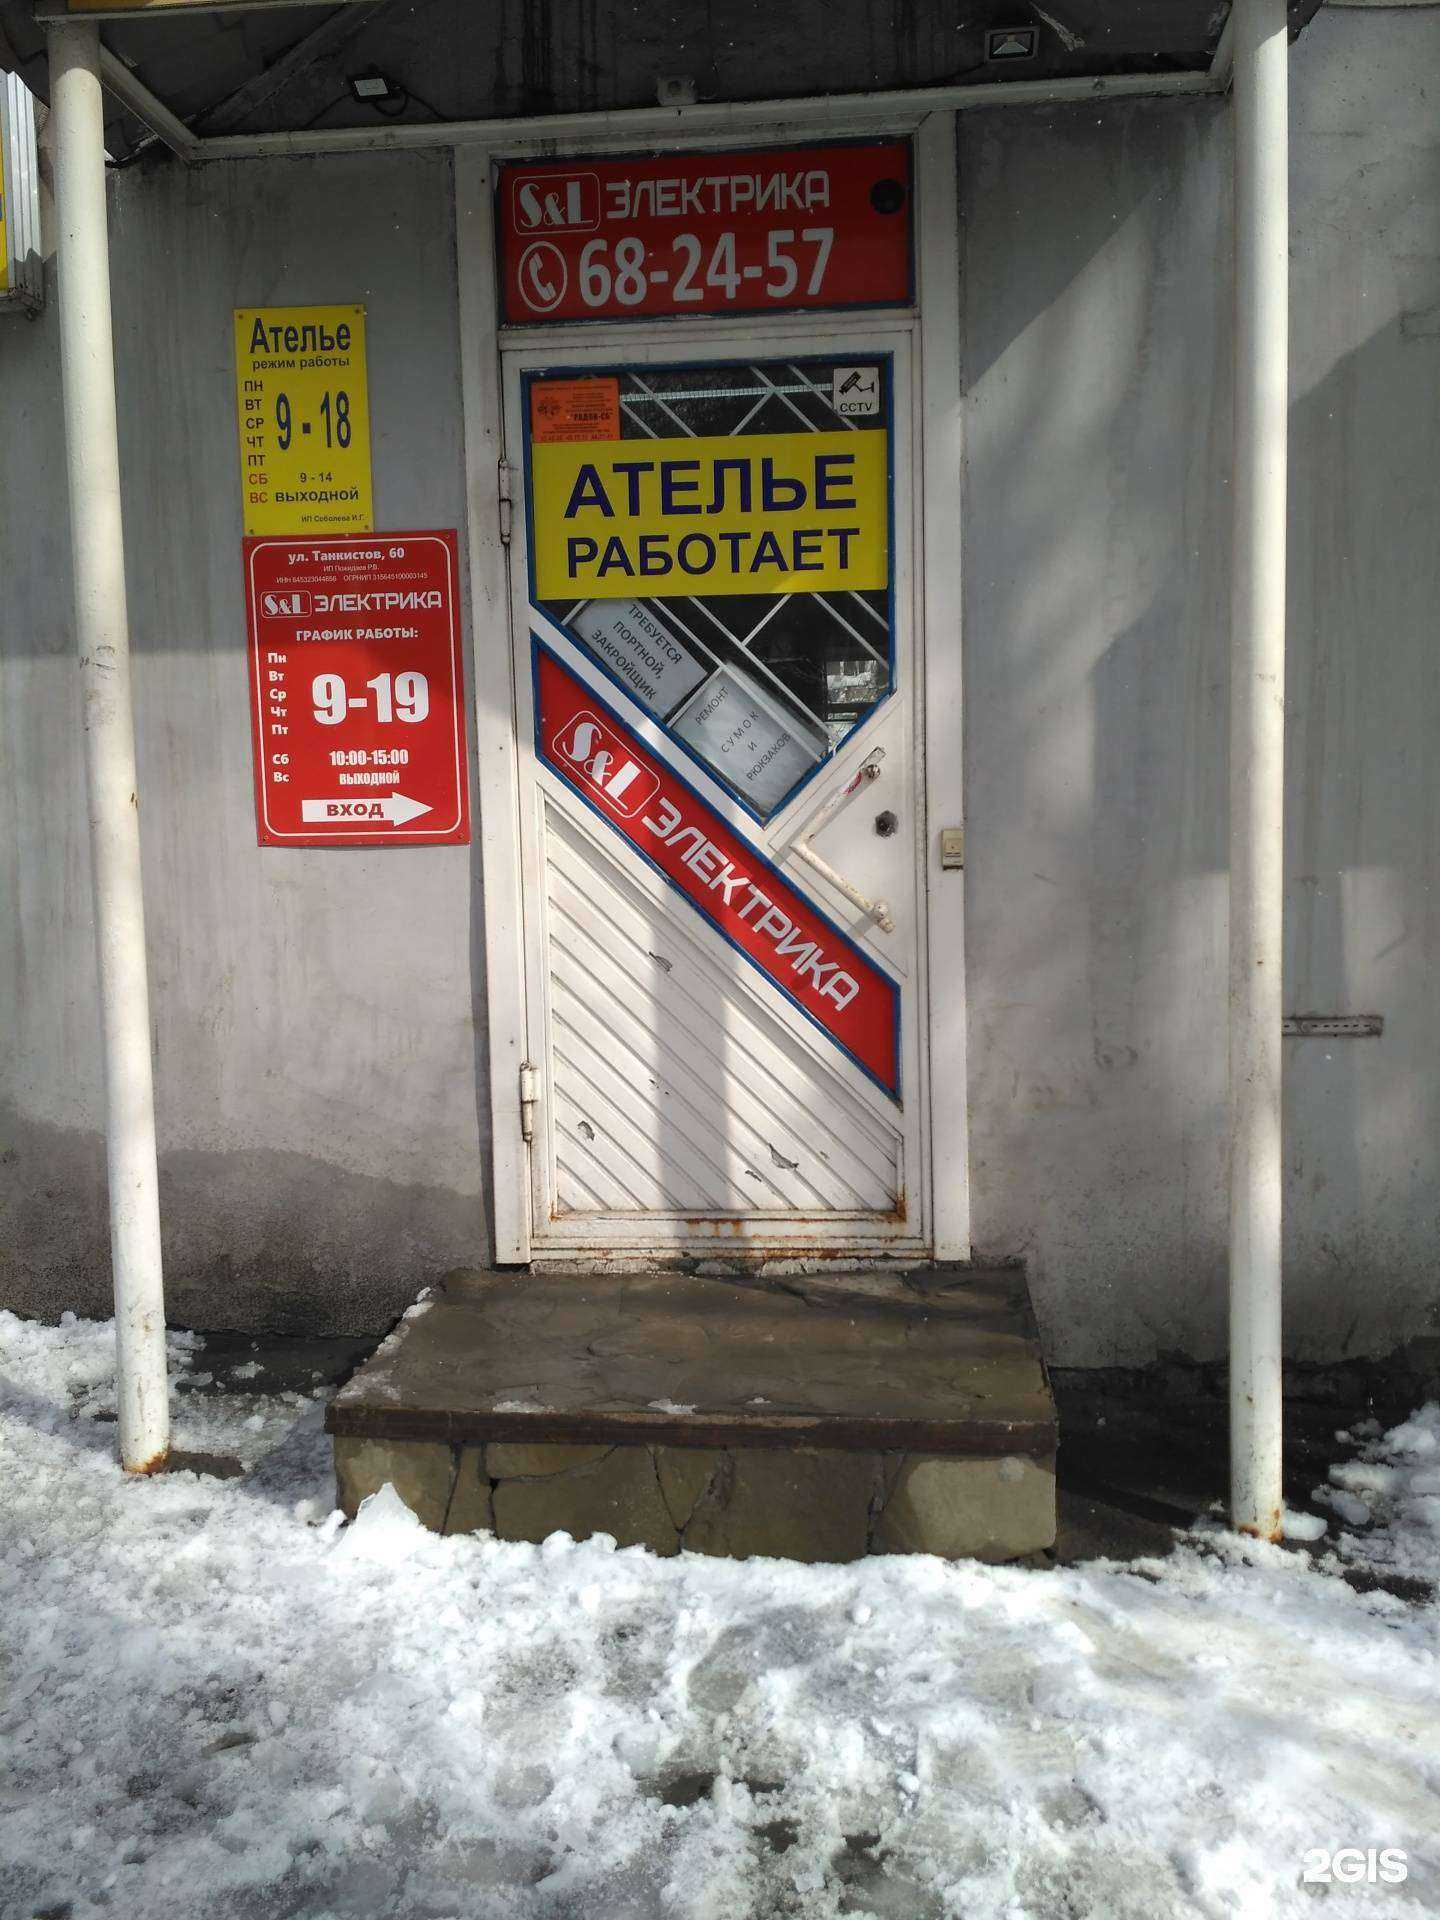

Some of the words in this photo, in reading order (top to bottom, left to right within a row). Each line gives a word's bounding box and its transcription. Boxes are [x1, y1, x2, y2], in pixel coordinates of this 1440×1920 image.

[605, 171, 831, 218] ЭЛЕКТРИКА
[519, 181, 594, 228] S&L
[579, 227, 835, 306] 68-24-57
[250, 317, 351, 353] Ателье
[252, 359, 296, 371] режим
[300, 356, 350, 370] работы
[244, 380, 264, 392] ПН
[245, 399, 262, 410] ВТ
[840, 402, 872, 413] CCTV
[246, 417, 264, 429] СР
[276, 392, 291, 450] 9
[320, 390, 351, 448] 18
[247, 436, 264, 448] ЧТ
[248, 455, 266, 467] ПТ
[249, 472, 268, 485] СБ
[319, 471, 333, 482] 14
[564, 454, 857, 519] АТЕЛЬЕ
[250, 492, 268, 503] ВС
[288, 552, 309, 565] ул.
[312, 549, 385, 562] Танкистов,
[389, 547, 405, 559] 60
[567, 528, 860, 578] РАБОТАЕТ
[314, 590, 442, 612] ЭЛЕКТРИКА
[296, 629, 353, 641] ГРАФИК
[356, 627, 419, 640] РАБОТЫ:
[629, 604, 682, 664] ТРЕБУЕТСЯ
[613, 621, 664, 679] ПОРТНОЙ,
[268, 653, 286, 664] Пн
[592, 630, 656, 700] ЗАКРОЙЩИК
[269, 671, 284, 682] Вт
[269, 689, 287, 701] Ср
[312, 671, 429, 725] 9-19
[271, 707, 287, 717] Чт
[695, 686, 728, 726] РЕМОНТ
[272, 725, 288, 735] Пт
[273, 754, 289, 765] Сб
[329, 749, 409, 766] 10:00-15:00
[746, 733, 791, 780] РЮКЗАКОВ
[273, 772, 290, 782] Вс
[326, 803, 384, 818] ВХОД
[642, 797, 860, 1012] ЭЛЕКТРИКА
